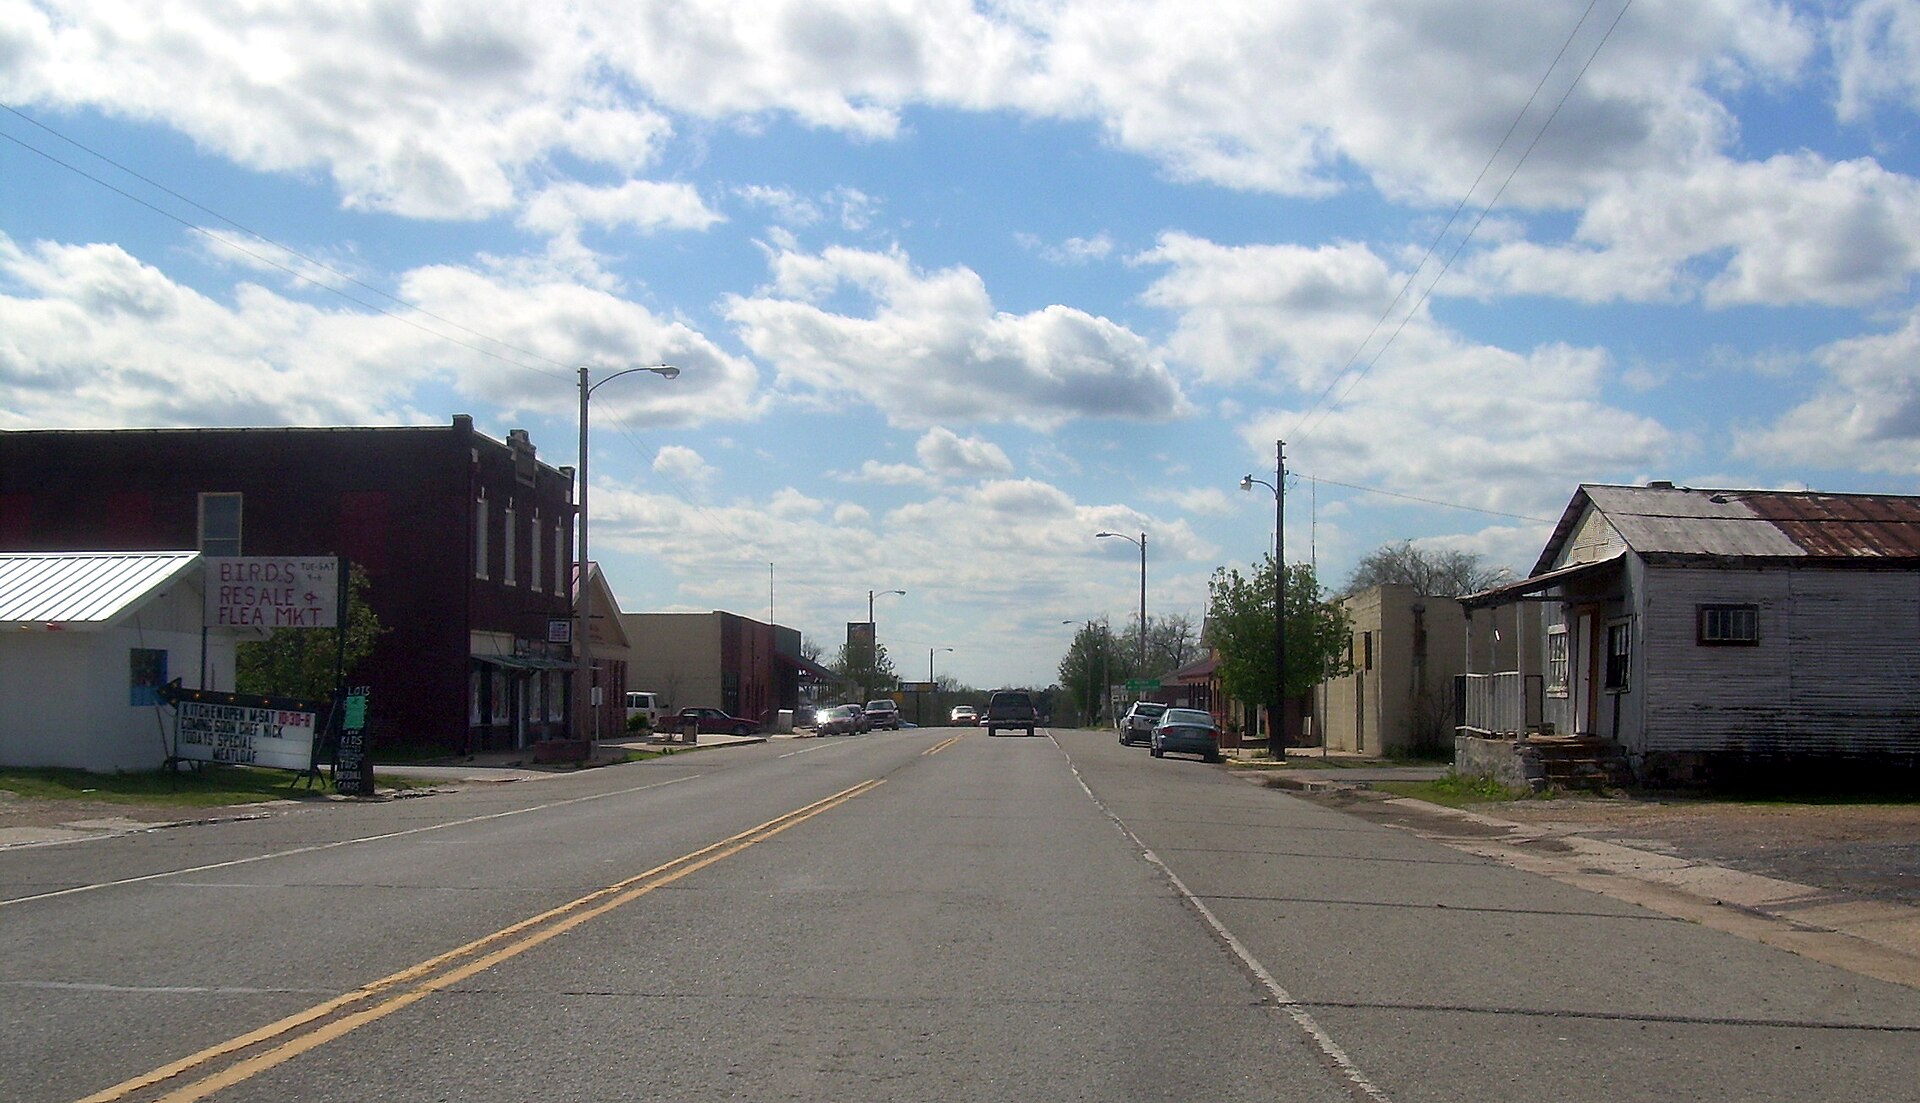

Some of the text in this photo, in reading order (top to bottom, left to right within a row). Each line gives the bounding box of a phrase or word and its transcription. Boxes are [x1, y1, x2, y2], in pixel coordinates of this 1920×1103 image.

[220, 585, 296, 606] RESALE
[218, 607, 264, 625] FLEA
[348, 686, 370, 696] LOTS
[214, 720, 237, 735] SOON
[238, 721, 260, 737] CHEF
[341, 736, 363, 746] KIDS
